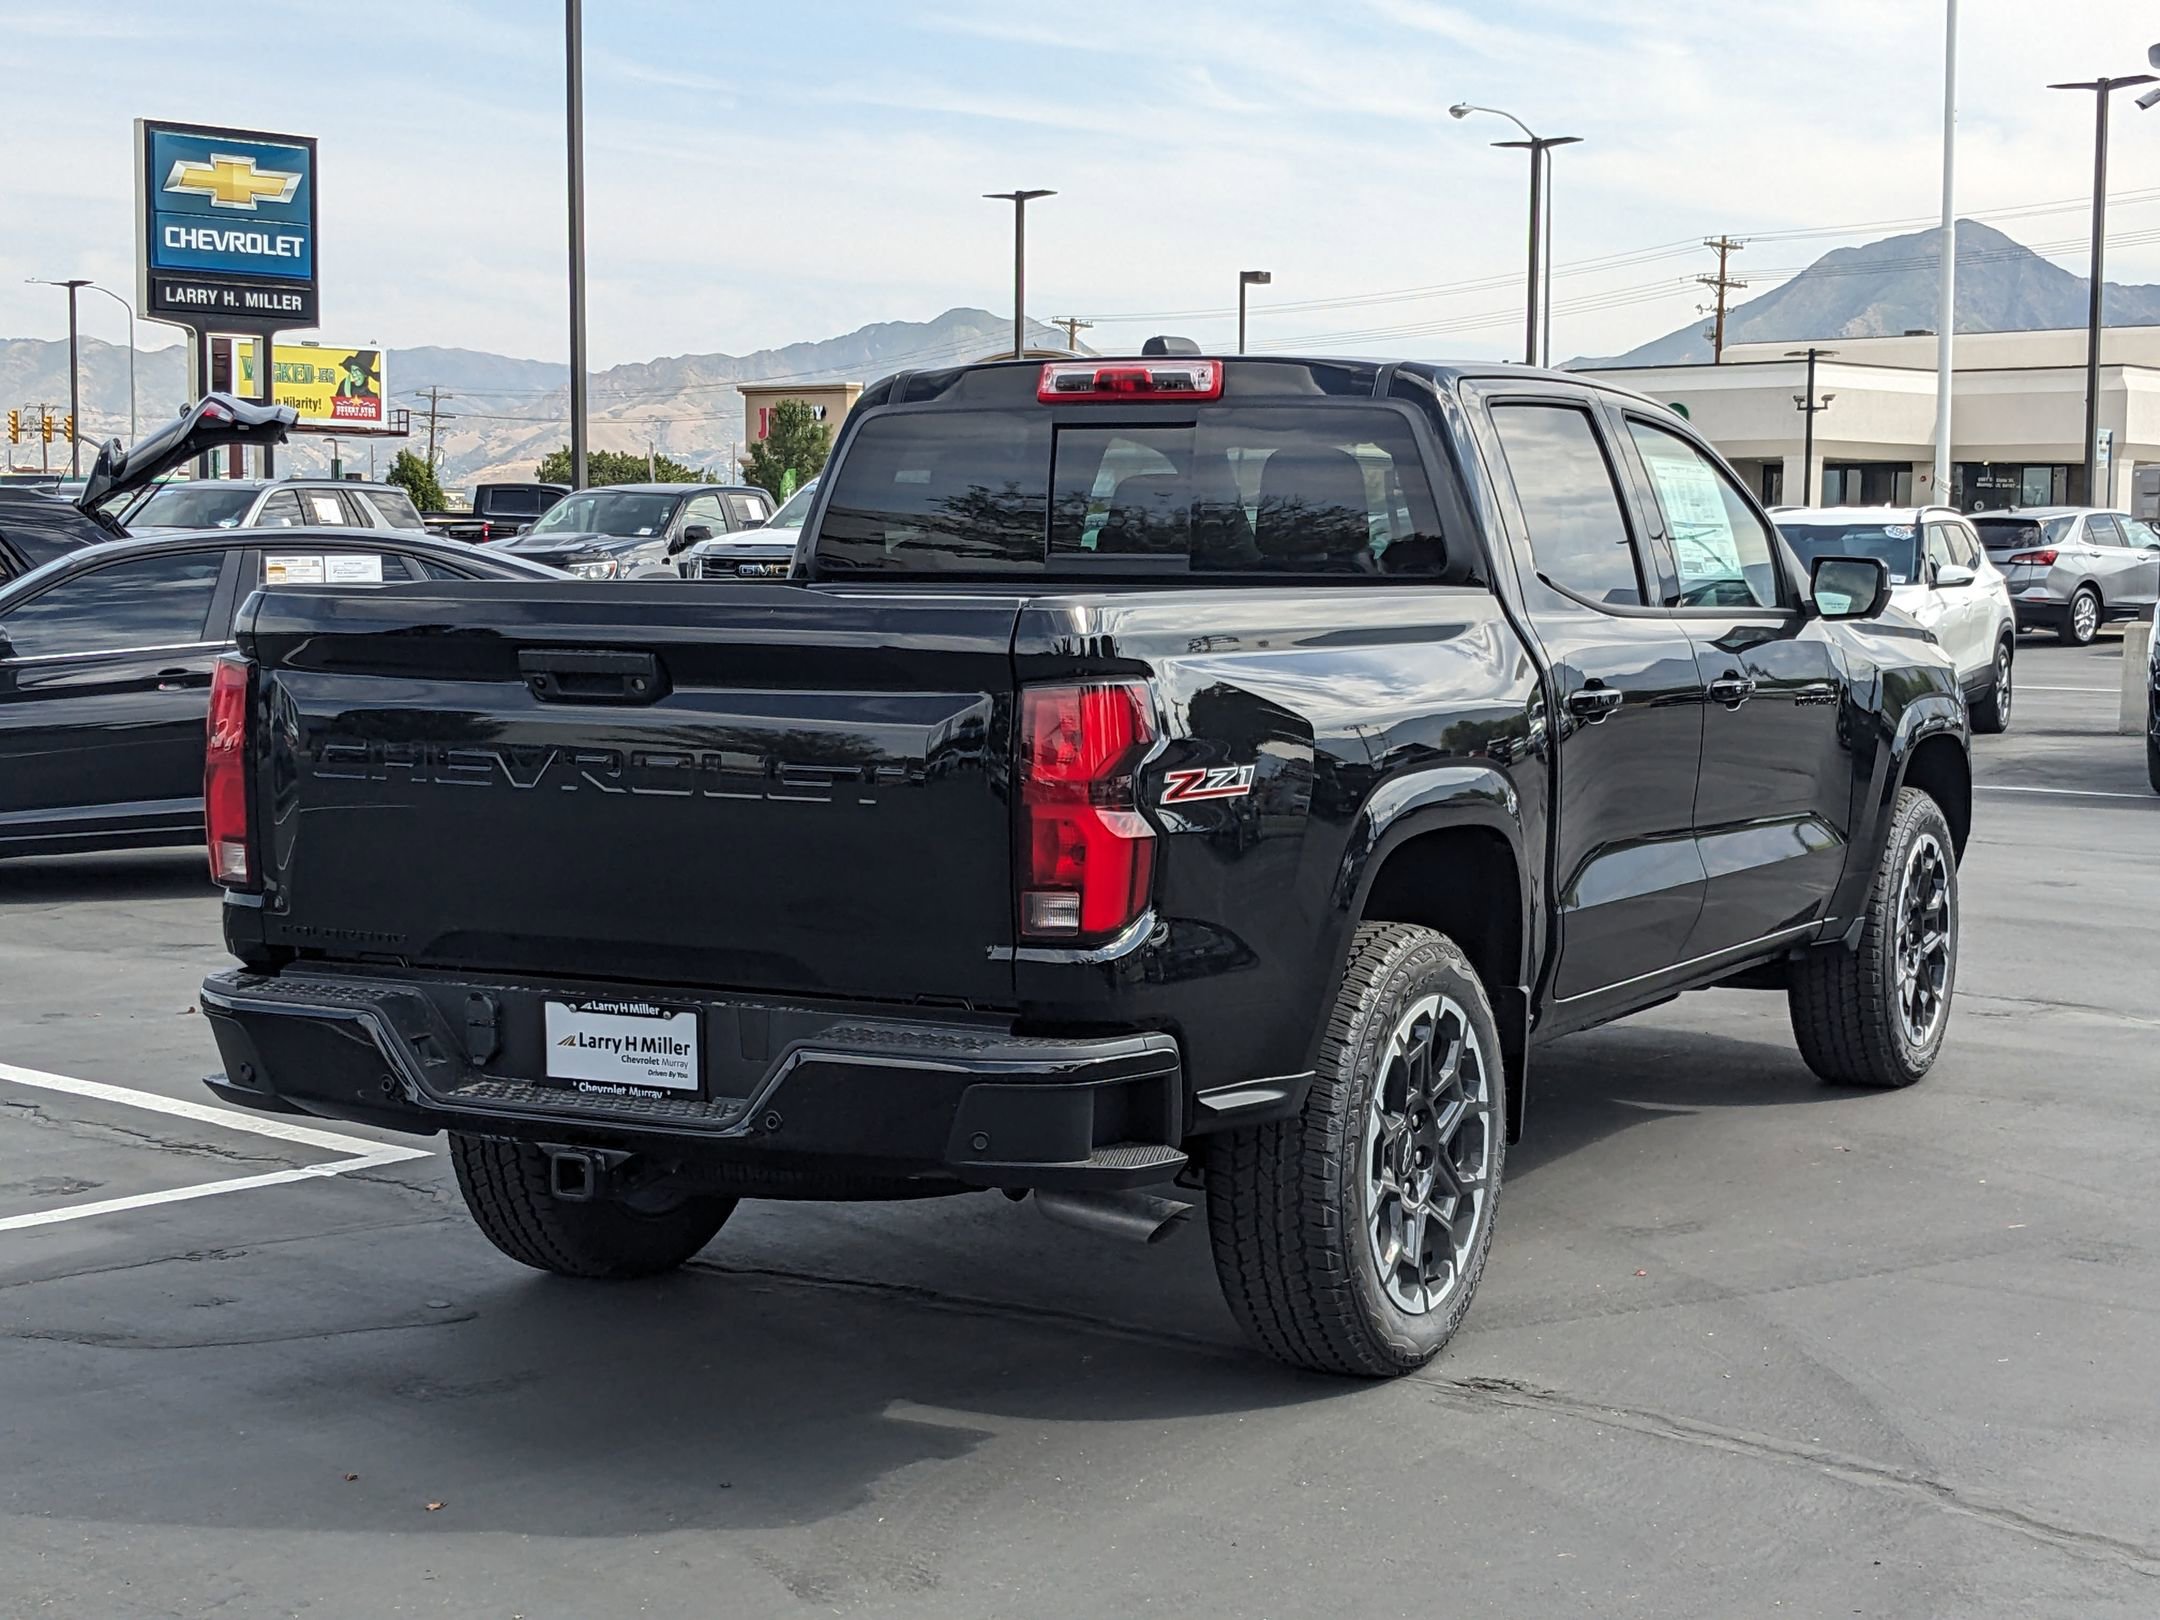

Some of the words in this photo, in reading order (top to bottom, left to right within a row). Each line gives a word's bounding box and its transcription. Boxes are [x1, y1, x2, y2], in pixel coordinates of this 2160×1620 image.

[165, 227, 304, 257] CHEVROLET
[165, 286, 218, 306] LARRY
[223, 290, 239, 308] H.
[245, 292, 302, 311] MILLER
[283, 396, 322, 413] Hilarity!
[739, 564, 790, 576] GMC
[312, 742, 907, 805] CHEVROLET
[1160, 764, 1256, 805] Z71
[592, 1000, 619, 1014] Larry
[620, 1003, 629, 1013] H
[629, 1004, 660, 1016] Miller
[578, 1032, 622, 1054] Larry
[625, 1035, 637, 1052] H
[641, 1037, 691, 1056] Miller
[621, 1054, 660, 1066] Chevrolet
[661, 1058, 688, 1069] Murray
[647, 1069, 667, 1077] Driven
[668, 1071, 676, 1079] By
[578, 1081, 627, 1095] Chevrolet
[628, 1087, 663, 1099] Murray
